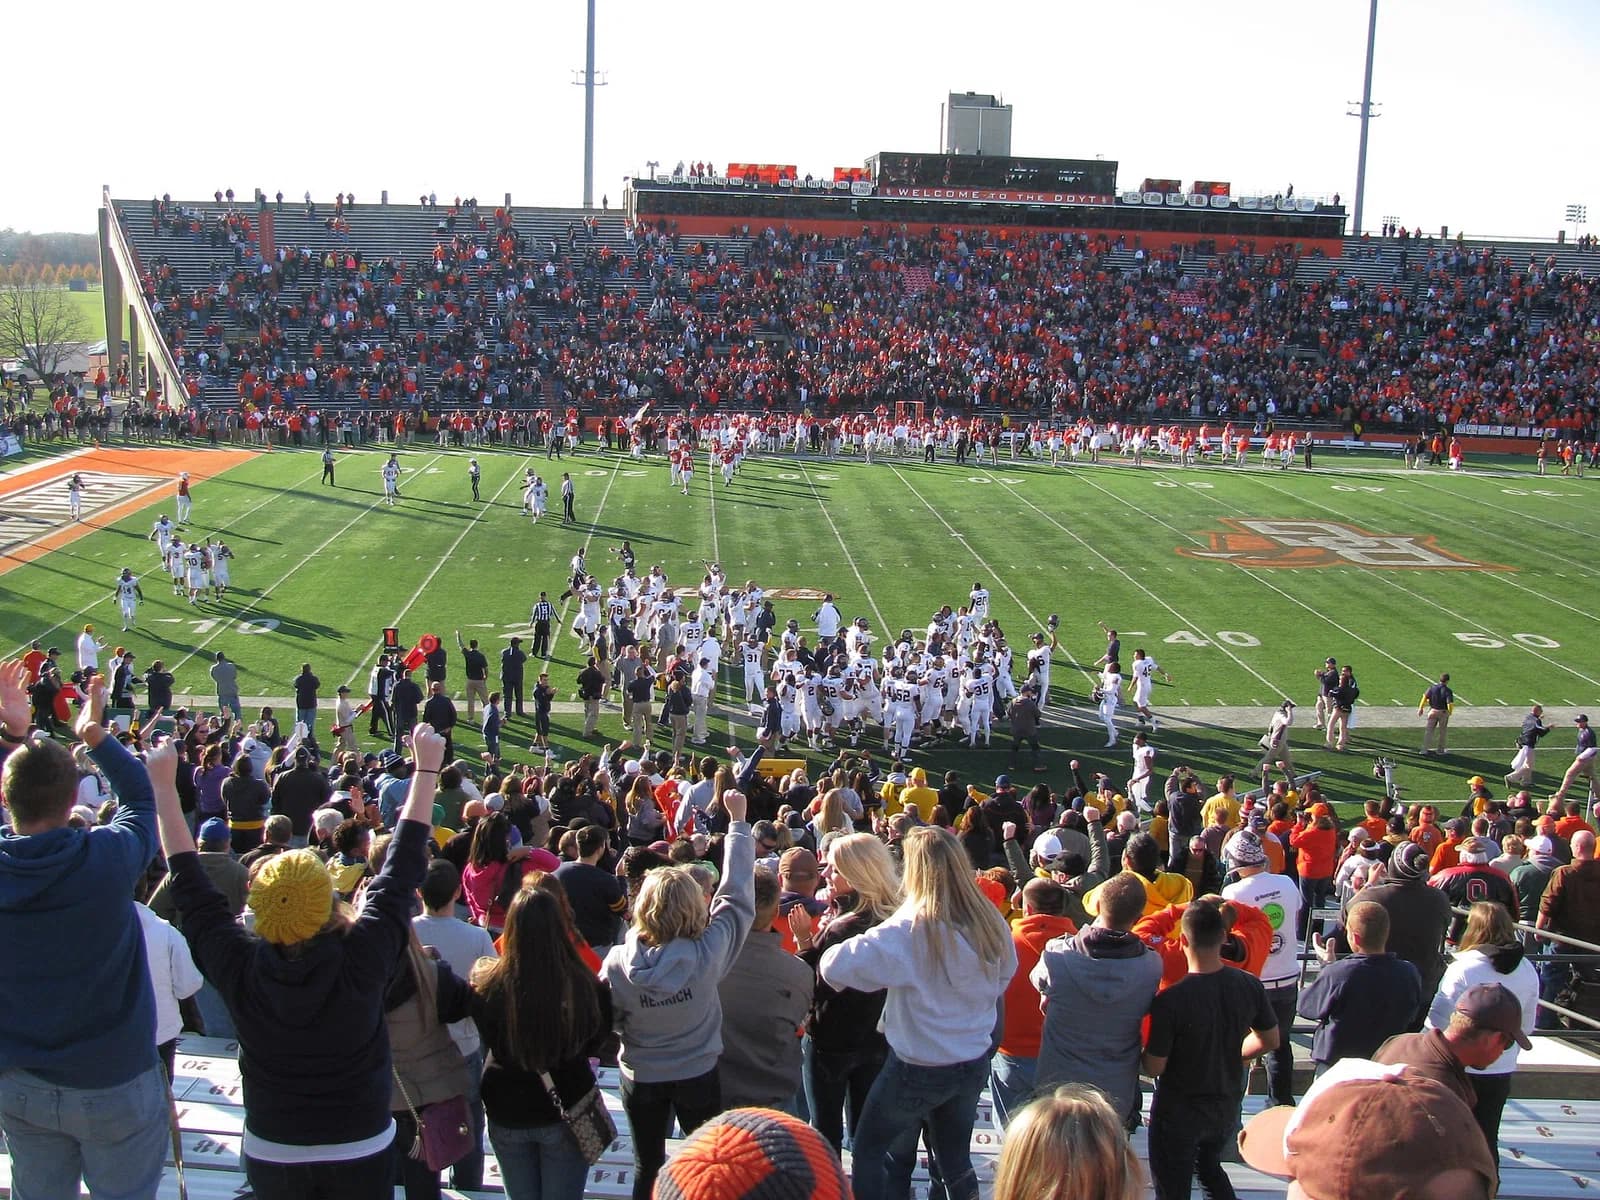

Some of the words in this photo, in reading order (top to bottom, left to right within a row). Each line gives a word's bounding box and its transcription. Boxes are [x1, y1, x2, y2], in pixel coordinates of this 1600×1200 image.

[898, 188, 980, 199] WELCOME
[990, 192, 1007, 200] TO
[1017, 194, 1044, 202] THE
[686, 628, 700, 639] 23
[1163, 630, 1262, 647] 40
[1452, 631, 1561, 648] 50
[746, 653, 758, 663] 31
[896, 688, 911, 702] 52
